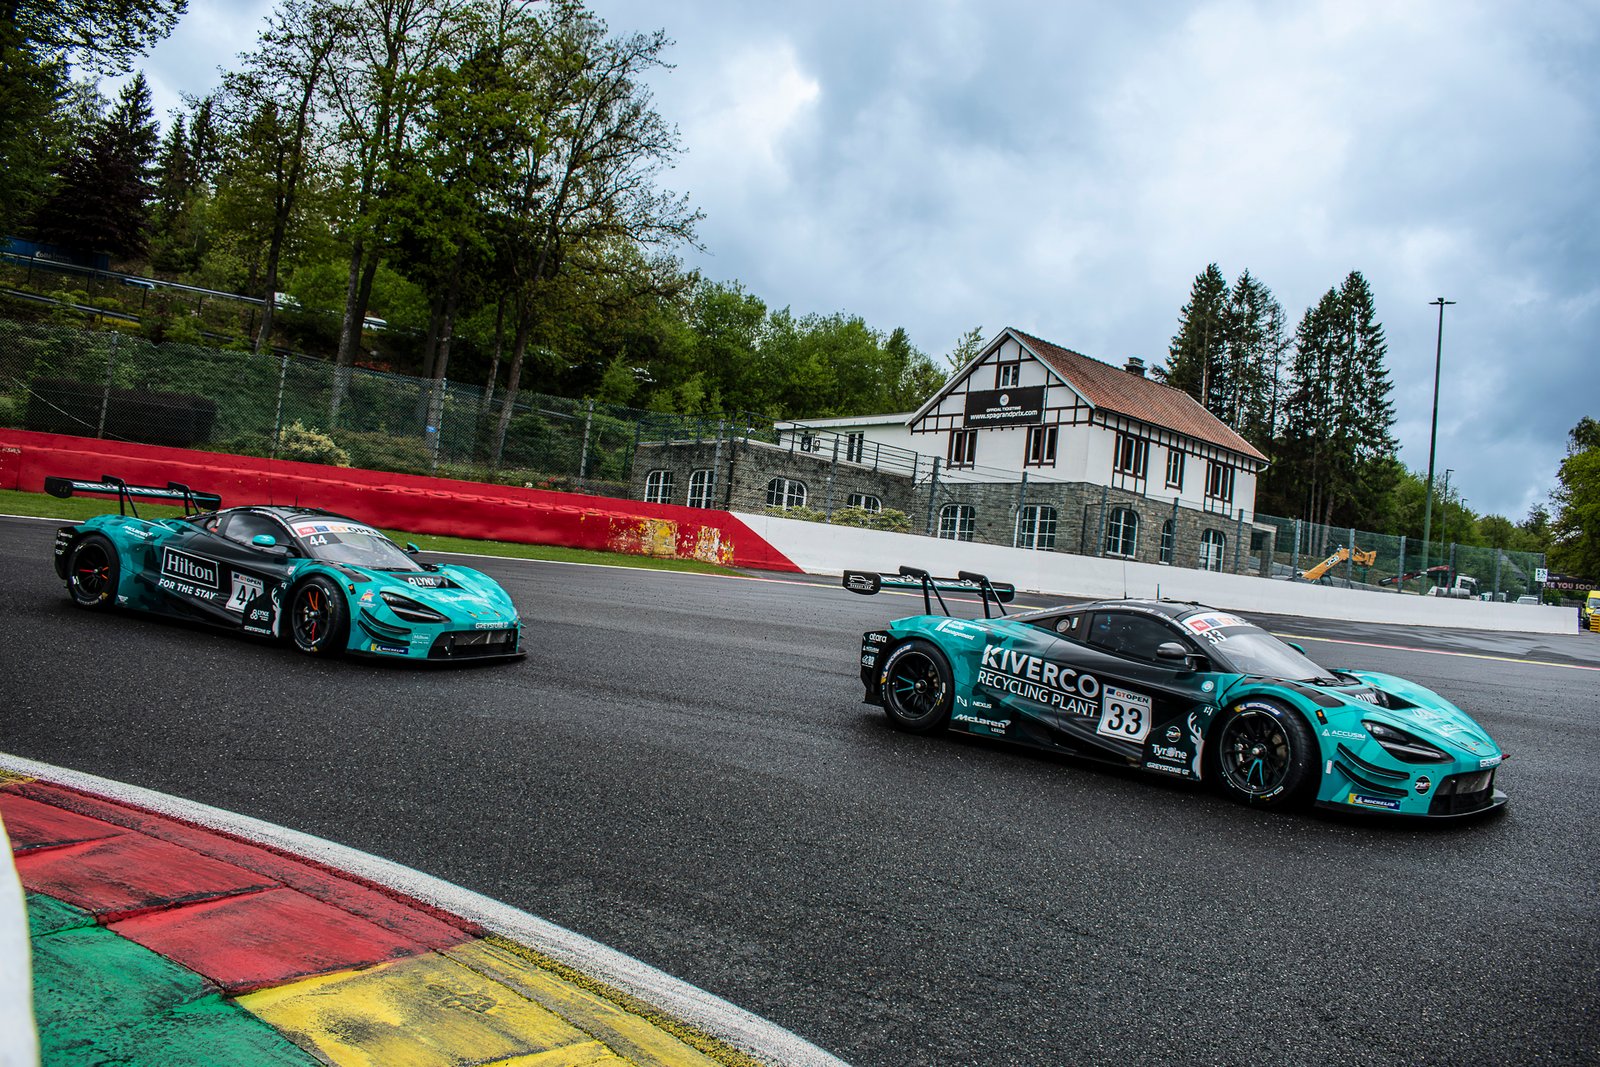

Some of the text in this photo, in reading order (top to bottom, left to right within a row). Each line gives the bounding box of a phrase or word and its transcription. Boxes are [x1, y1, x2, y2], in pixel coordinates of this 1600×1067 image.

[970, 410, 1038, 420] www.spagrandprix.com
[309, 534, 328, 546] 44
[166, 553, 215, 583] Hilton
[158, 578, 216, 600] FOR THE STAY
[1202, 629, 1228, 645] 33
[981, 644, 1099, 698] KIVERCO
[977, 671, 1049, 703] RECYCLING
[1051, 693, 1098, 718] PLANT
[1115, 690, 1149, 704] GTOPEN
[972, 700, 993, 709] NEXUS
[954, 714, 1007, 729] McLaren
[1107, 703, 1143, 735] 33
[990, 727, 1006, 735] LEEDS
[1331, 730, 1366, 738] ACCUSIM
[1146, 761, 1182, 774] GREYSTONE
[1363, 799, 1396, 807] MICHELIN
